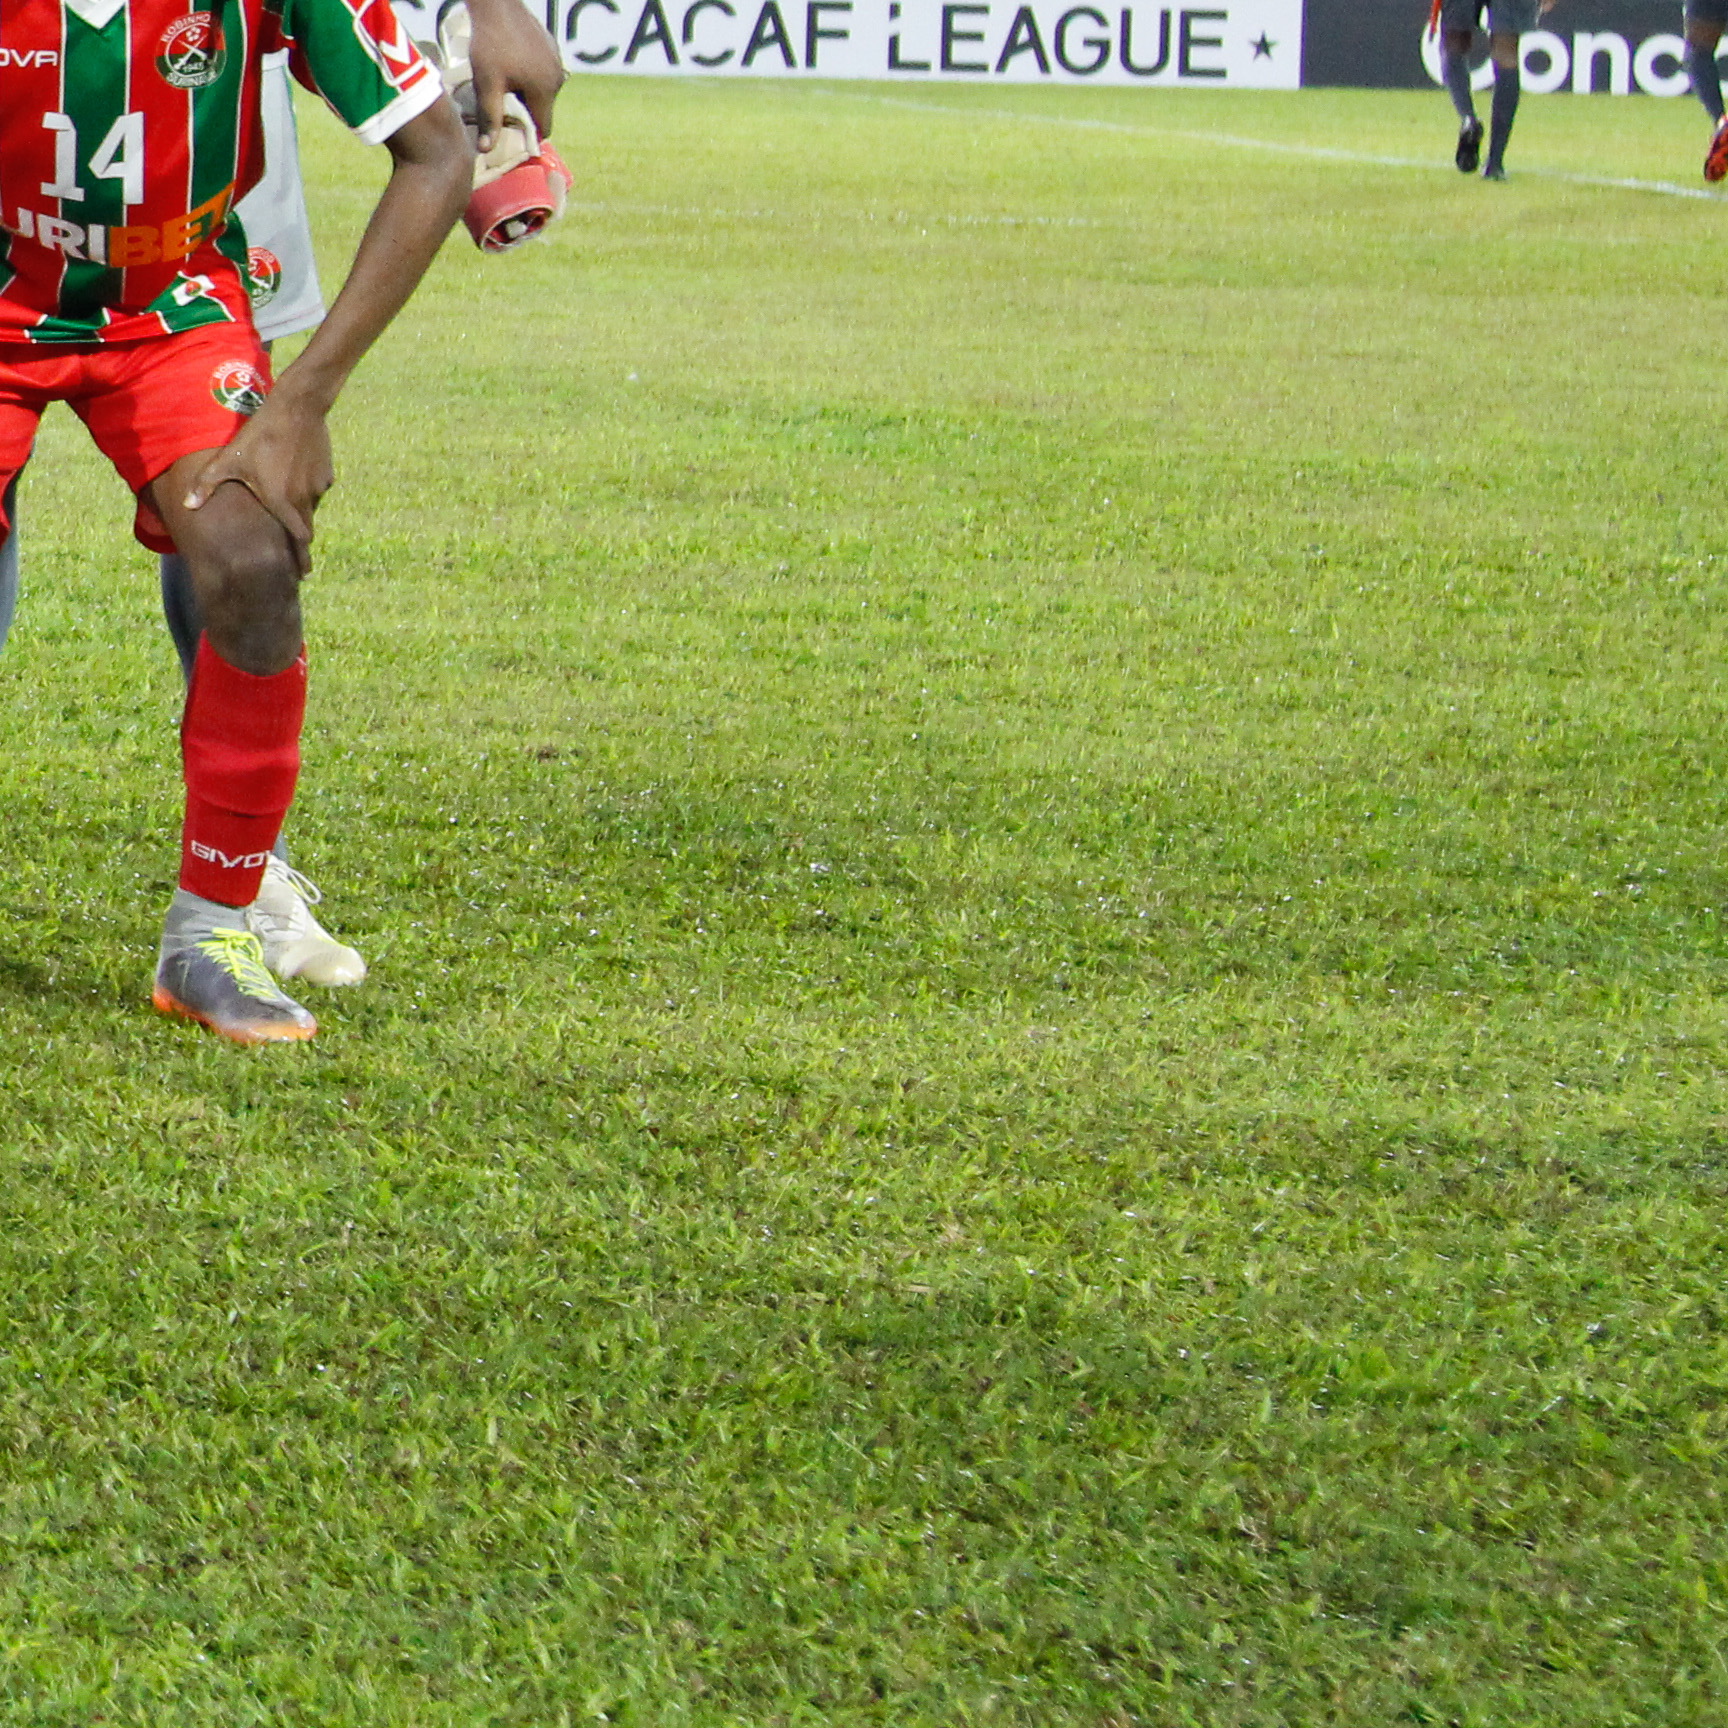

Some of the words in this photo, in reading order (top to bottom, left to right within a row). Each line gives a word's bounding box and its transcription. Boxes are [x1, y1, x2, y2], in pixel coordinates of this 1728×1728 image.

[888, 1, 1229, 79] LEAGUE
[40, 111, 144, 205] 14
[190, 839, 269, 869] GIVO
